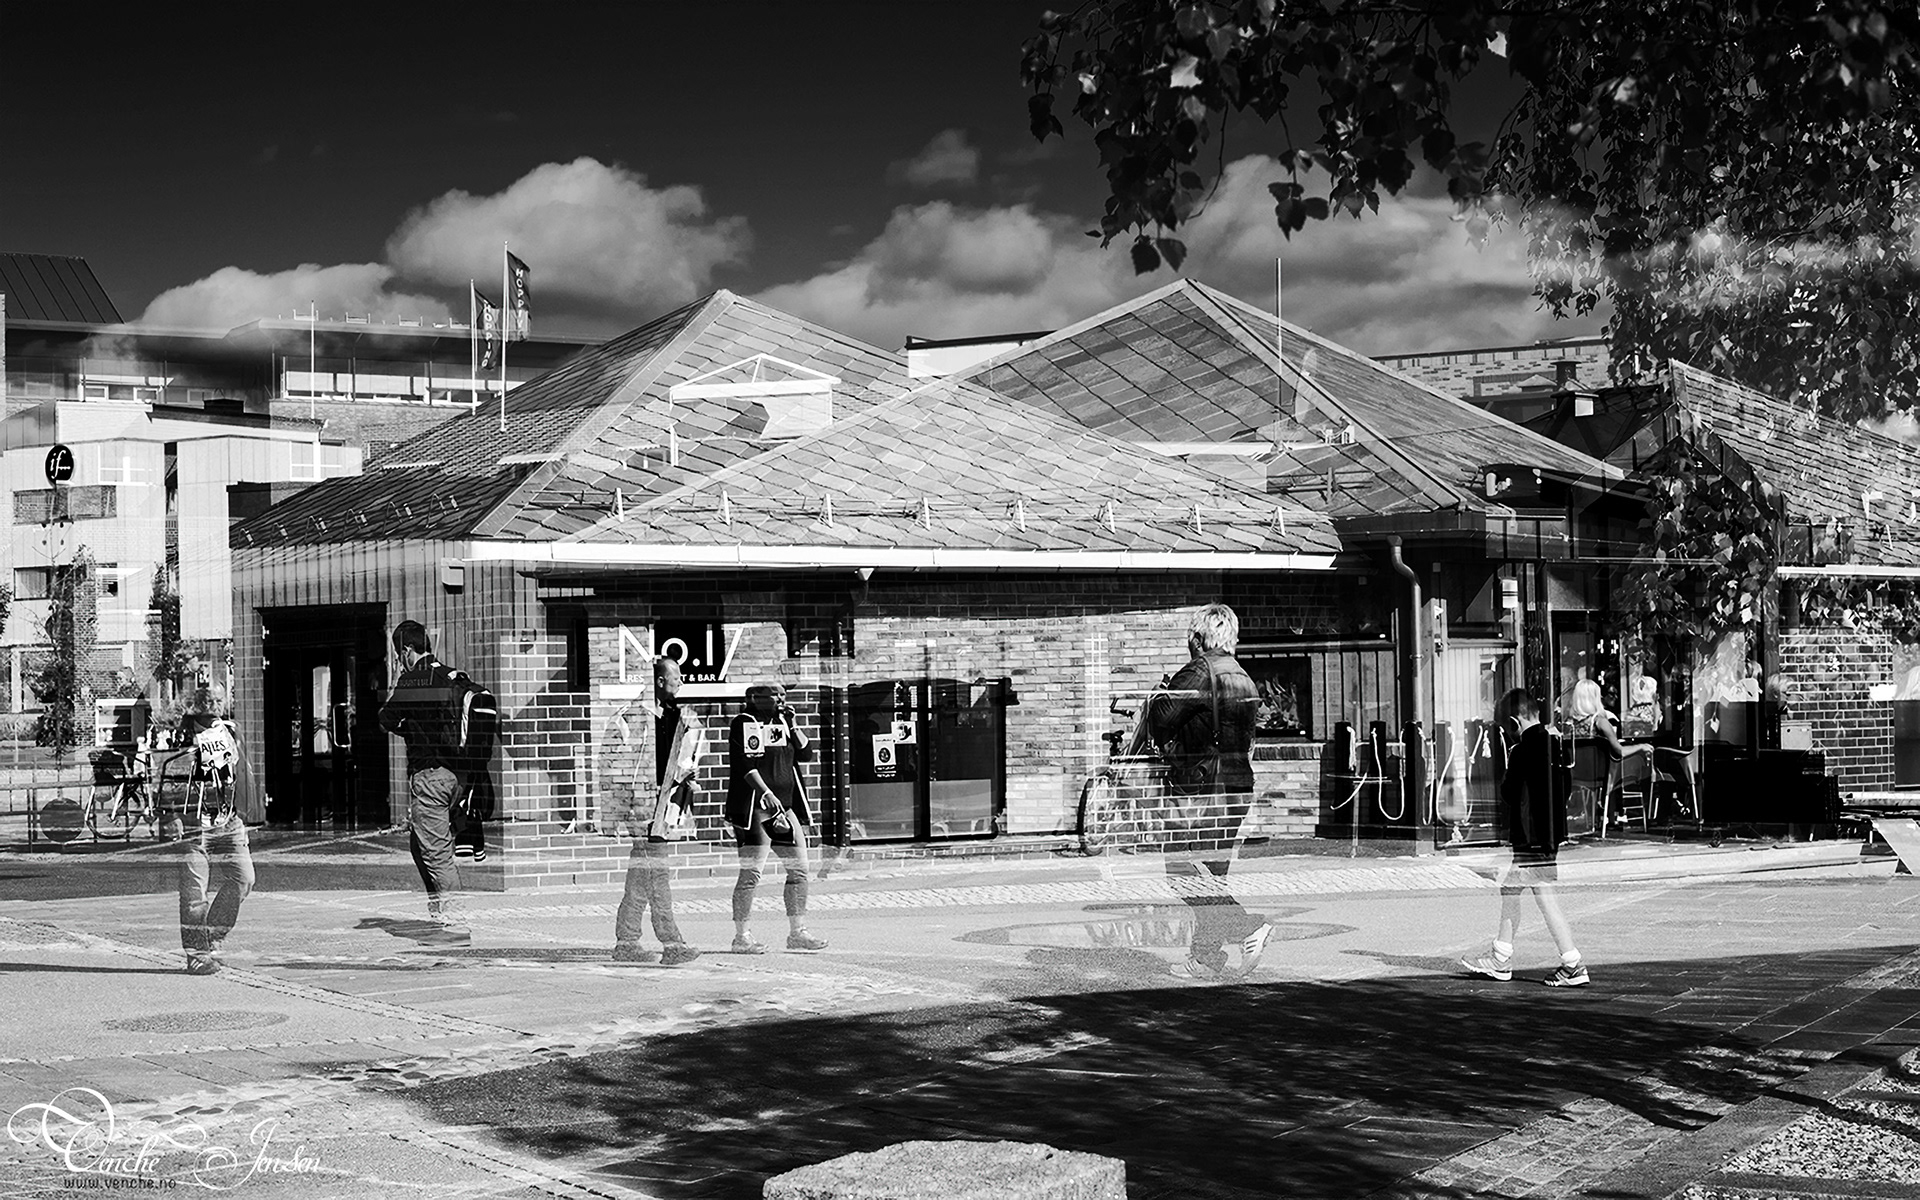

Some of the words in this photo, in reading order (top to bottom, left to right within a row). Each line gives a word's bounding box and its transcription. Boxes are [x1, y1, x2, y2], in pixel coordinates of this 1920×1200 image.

[481, 299, 493, 367] HOPPING
[619, 623, 745, 683] No.17
[697, 673, 716, 681] BAR
